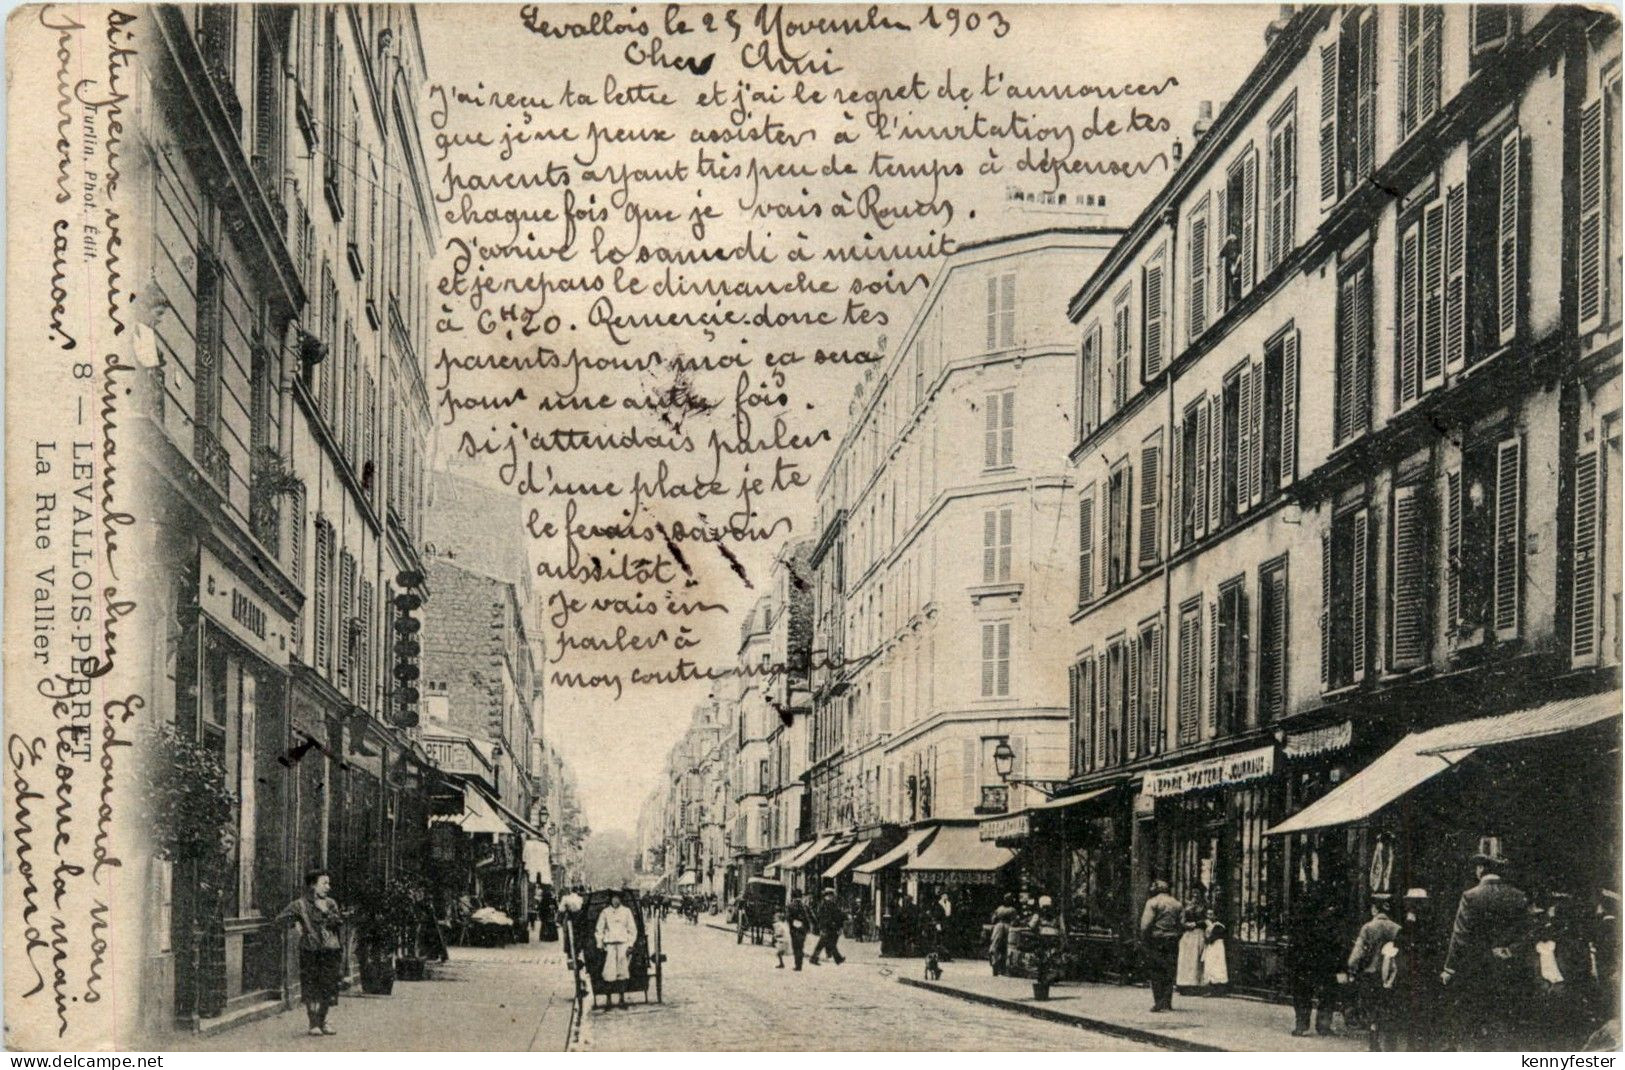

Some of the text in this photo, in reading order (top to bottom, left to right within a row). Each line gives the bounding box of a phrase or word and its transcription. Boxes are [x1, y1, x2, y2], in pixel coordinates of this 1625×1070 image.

[520, 4, 649, 39] Levallois
[664, 4, 694, 36] le
[919, 7, 1010, 38] 1903
[83, 79, 98, 92] L.
[625, 37, 843, 76] Cher Ami
[40, 4, 85, 204] pourrons
[559, 80, 598, 107] ta
[603, 74, 677, 106] lettre
[695, 90, 728, 107] et
[730, 81, 786, 126] j'ai
[794, 80, 826, 104] le
[833, 72, 929, 128] regret
[937, 68, 974, 104] de
[979, 64, 1180, 97] t'annoncer
[75, 79, 129, 201] peux
[435, 104, 1171, 165] que je ne peux assister à l'invitation de tes
[84, 171, 98, 213] Phot.
[436, 147, 1168, 210] parents ayant très peu de temps à dépenser
[445, 193, 558, 246] chaque
[563, 189, 608, 251] fois
[624, 201, 681, 250] que
[688, 189, 722, 240] je
[751, 188, 822, 220] vais
[831, 190, 854, 218] à
[636, 230, 778, 265] samedi
[787, 231, 815, 262] à
[823, 229, 957, 262] minuit
[105, 208, 136, 336] venir
[437, 267, 468, 296] et
[471, 264, 501, 311] je
[614, 266, 648, 295] le
[653, 266, 838, 297] dimanche
[850, 269, 930, 296] soir
[436, 304, 463, 333] à
[753, 302, 837, 328] donc
[842, 298, 889, 325] tes
[73, 363, 93, 379] 8
[435, 348, 560, 390] parents
[556, 348, 662, 398] pour
[668, 338, 752, 372] moi
[814, 348, 884, 365] sera
[439, 387, 528, 426] pour
[538, 392, 616, 412] une
[622, 385, 724, 411] autre
[101, 353, 135, 580] dimanche
[458, 418, 831, 485] si j'attendais parler
[518, 456, 811, 530] d'une place je te
[34, 441, 56, 664] La Rue Vallier
[526, 499, 792, 572] le ferais savoir
[537, 548, 676, 583] aussitôt
[81, 586, 136, 677] chez
[548, 590, 587, 628] Je
[591, 593, 657, 614] vais
[550, 626, 701, 663] parler à
[551, 667, 622, 700] mon
[53, 762, 74, 855] serre
[93, 695, 145, 884] Edouard
[8, 733, 49, 998] Edmond
[53, 860, 84, 910] la
[51, 916, 78, 1039] main
[85, 897, 112, 1003] nous
